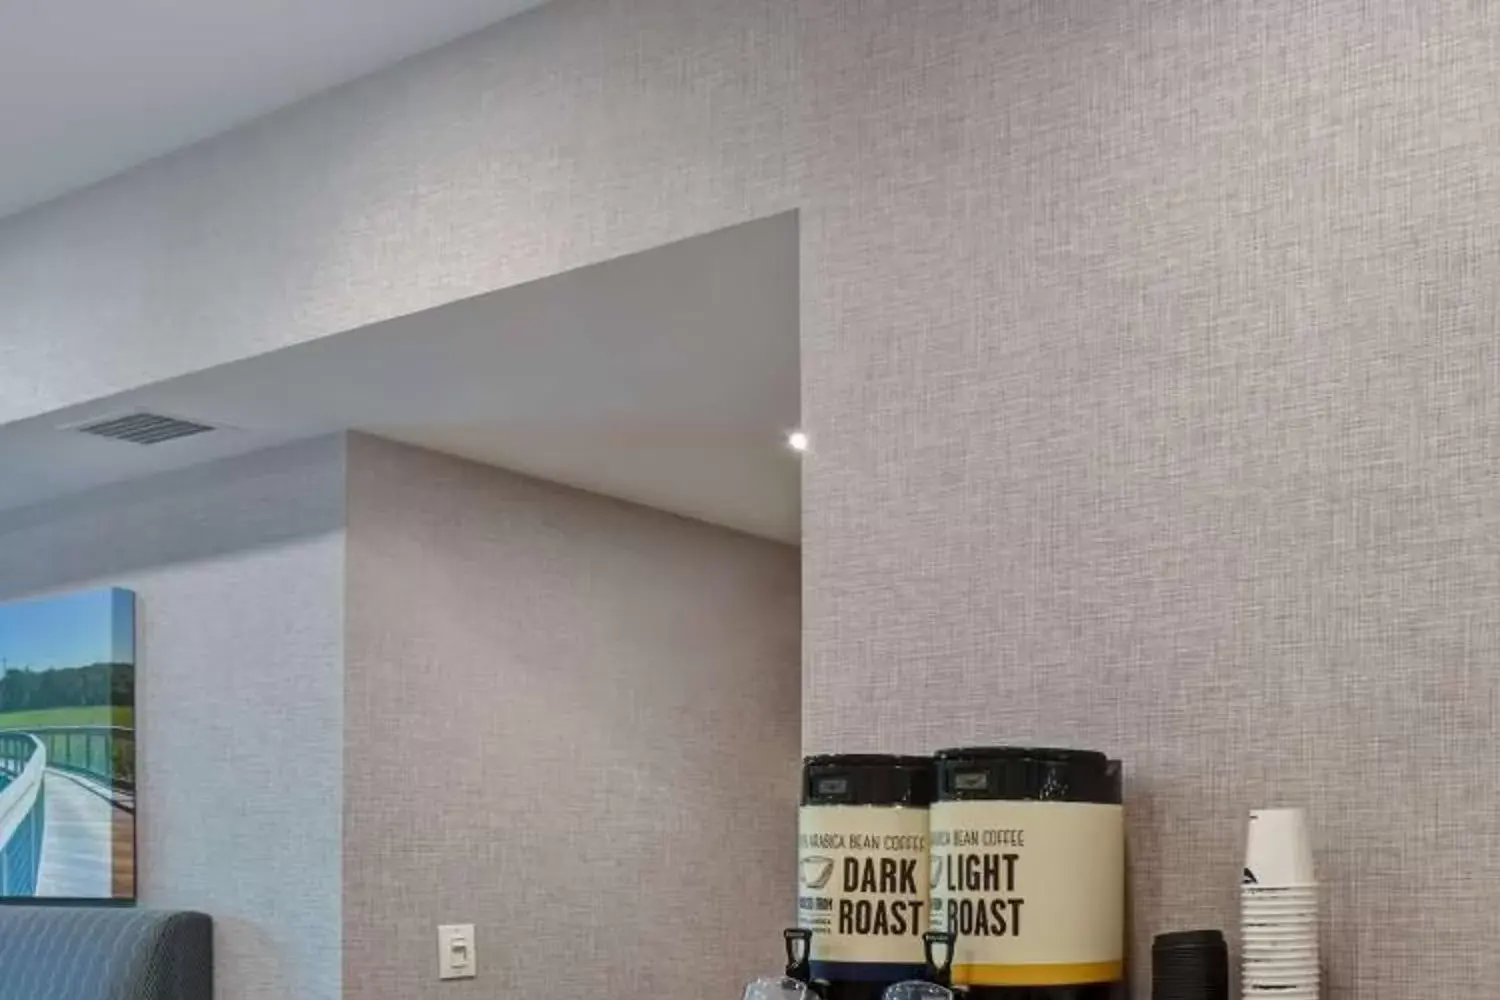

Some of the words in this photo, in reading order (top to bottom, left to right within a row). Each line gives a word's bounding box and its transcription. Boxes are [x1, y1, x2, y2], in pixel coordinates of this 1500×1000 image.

[849, 833, 879, 850] BEAN
[983, 829, 1025, 847] COFFEE
[843, 856, 917, 894] DARK
[947, 853, 1020, 892] LIGHT
[838, 899, 924, 936] ROAST
[947, 898, 1025, 937] ROAST
